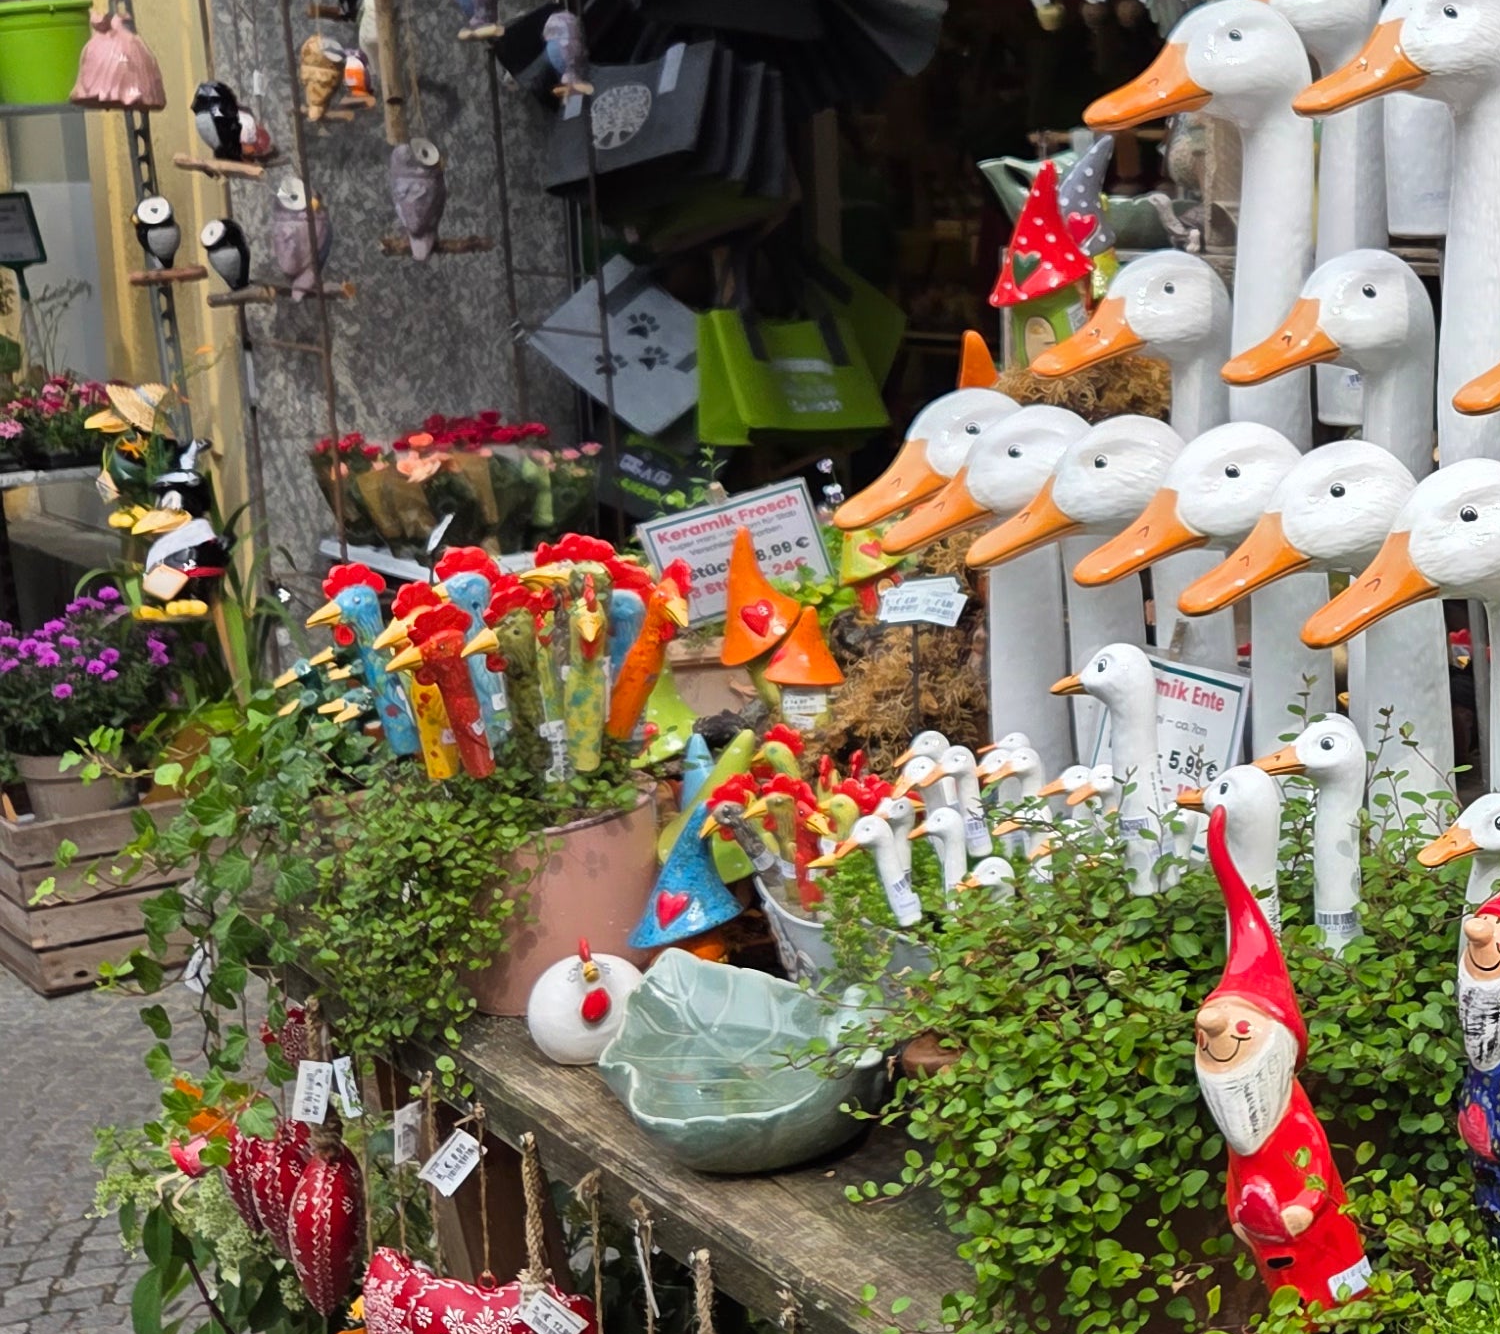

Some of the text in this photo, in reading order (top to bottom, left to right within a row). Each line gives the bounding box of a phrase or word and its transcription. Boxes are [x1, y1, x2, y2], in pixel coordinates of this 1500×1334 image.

[657, 494, 799, 544] Keramik Frosch
[796, 536, 810, 549] €
[1191, 686, 1225, 712] Ente
[1168, 750, 1218, 782] 5,99 €
